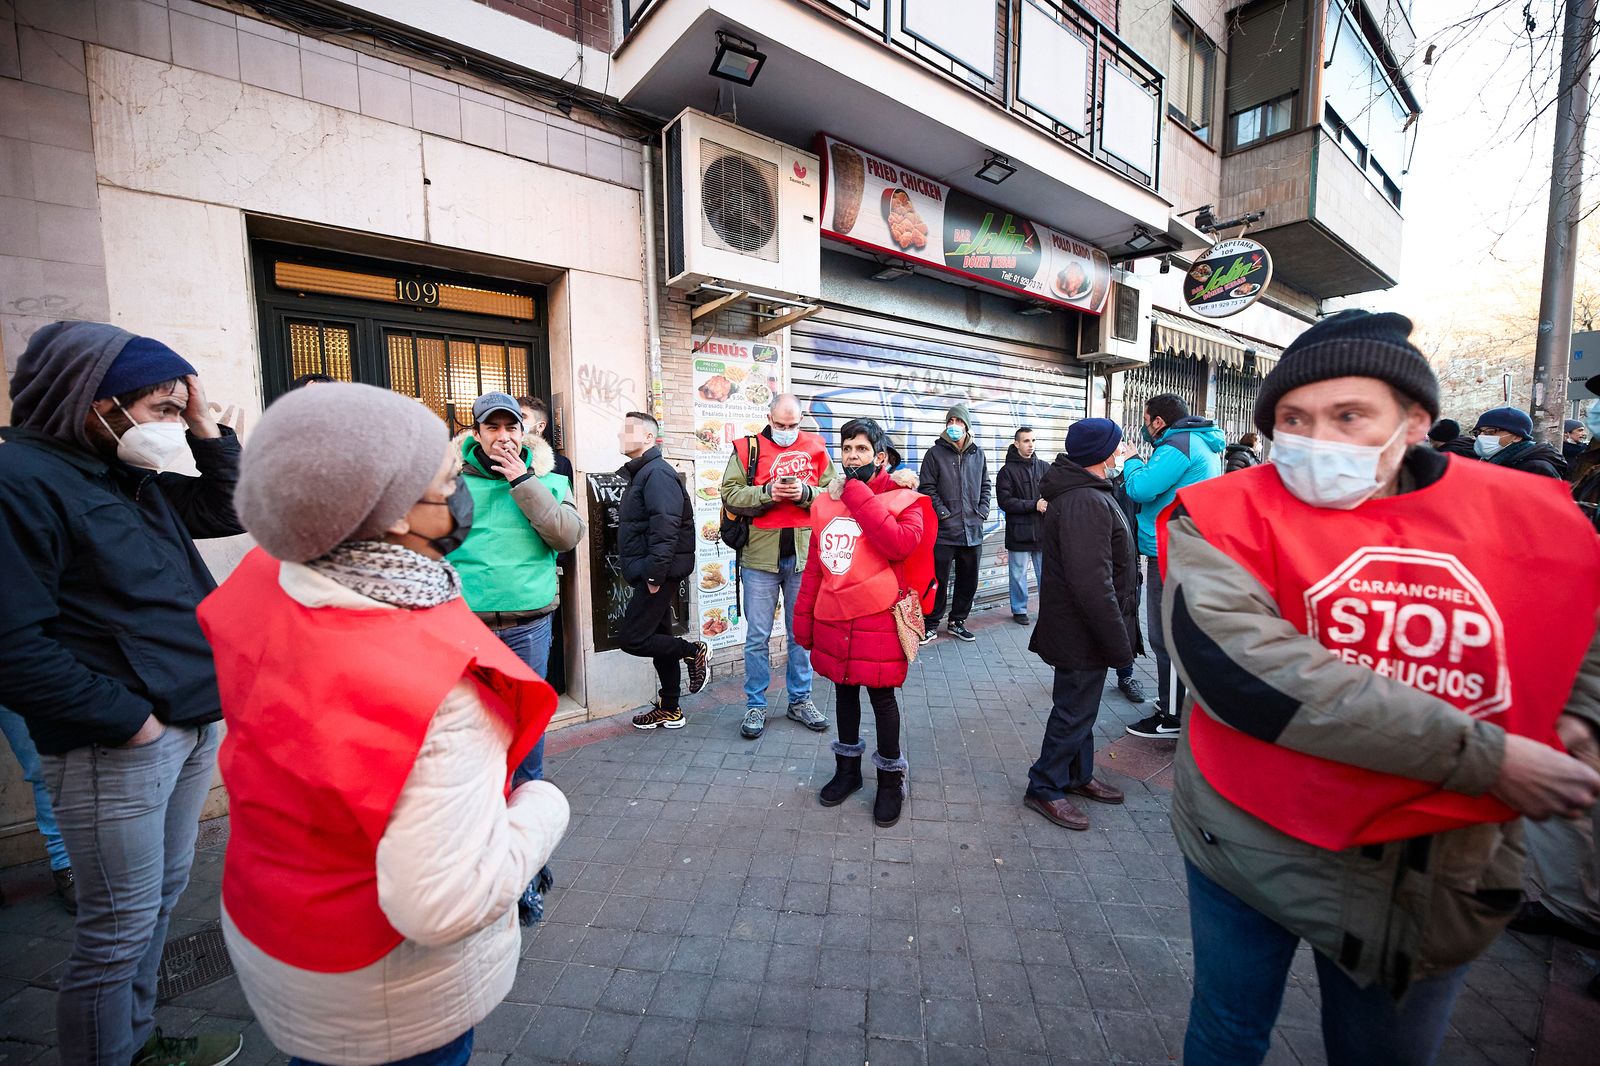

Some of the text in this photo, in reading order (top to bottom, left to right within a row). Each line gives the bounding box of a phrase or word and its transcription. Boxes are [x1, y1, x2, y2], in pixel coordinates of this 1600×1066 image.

[866, 157, 943, 202] FRIED CHICKEN
[953, 228, 971, 242] BAR
[1052, 233, 1091, 260] POLLO ASADO
[1214, 240, 1254, 252] CARPETANA
[1221, 248, 1234, 256] 109
[963, 252, 1017, 269] DÖNER KEBAB
[1013, 275, 1020, 283] 91
[396, 280, 437, 304] 109
[693, 340, 748, 359] MENÚS
[1348, 578, 1476, 606] CARAANCHEL
[1328, 596, 1492, 664] STOP
[1327, 648, 1486, 700] ESAHUCIOS
